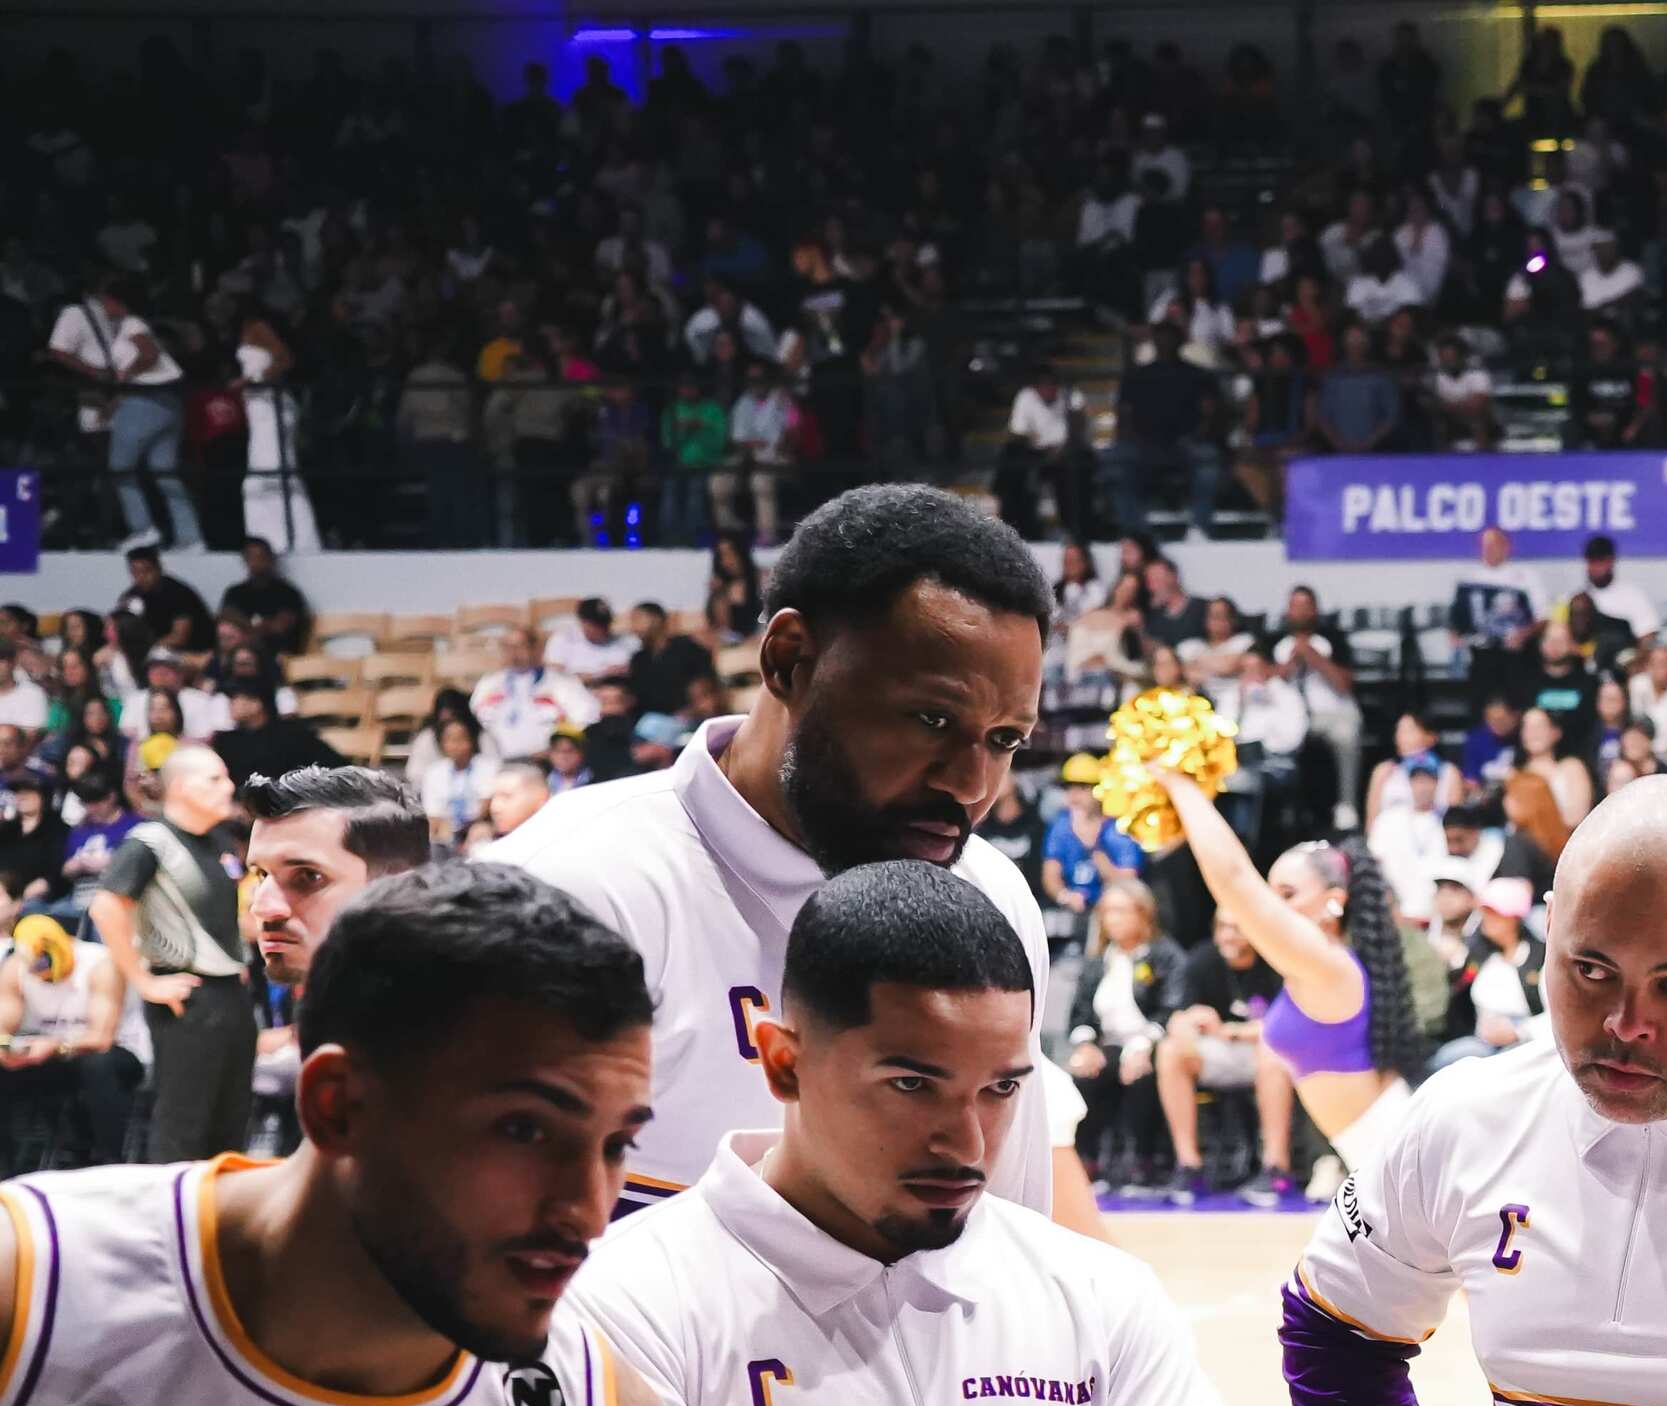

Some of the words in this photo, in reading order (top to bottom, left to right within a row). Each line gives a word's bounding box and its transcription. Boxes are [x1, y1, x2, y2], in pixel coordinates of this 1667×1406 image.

[1342, 483, 1486, 533] PALCO
[1497, 482, 1636, 531] OESTE
[728, 985, 771, 1063] C
[1492, 1202, 1531, 1275] C
